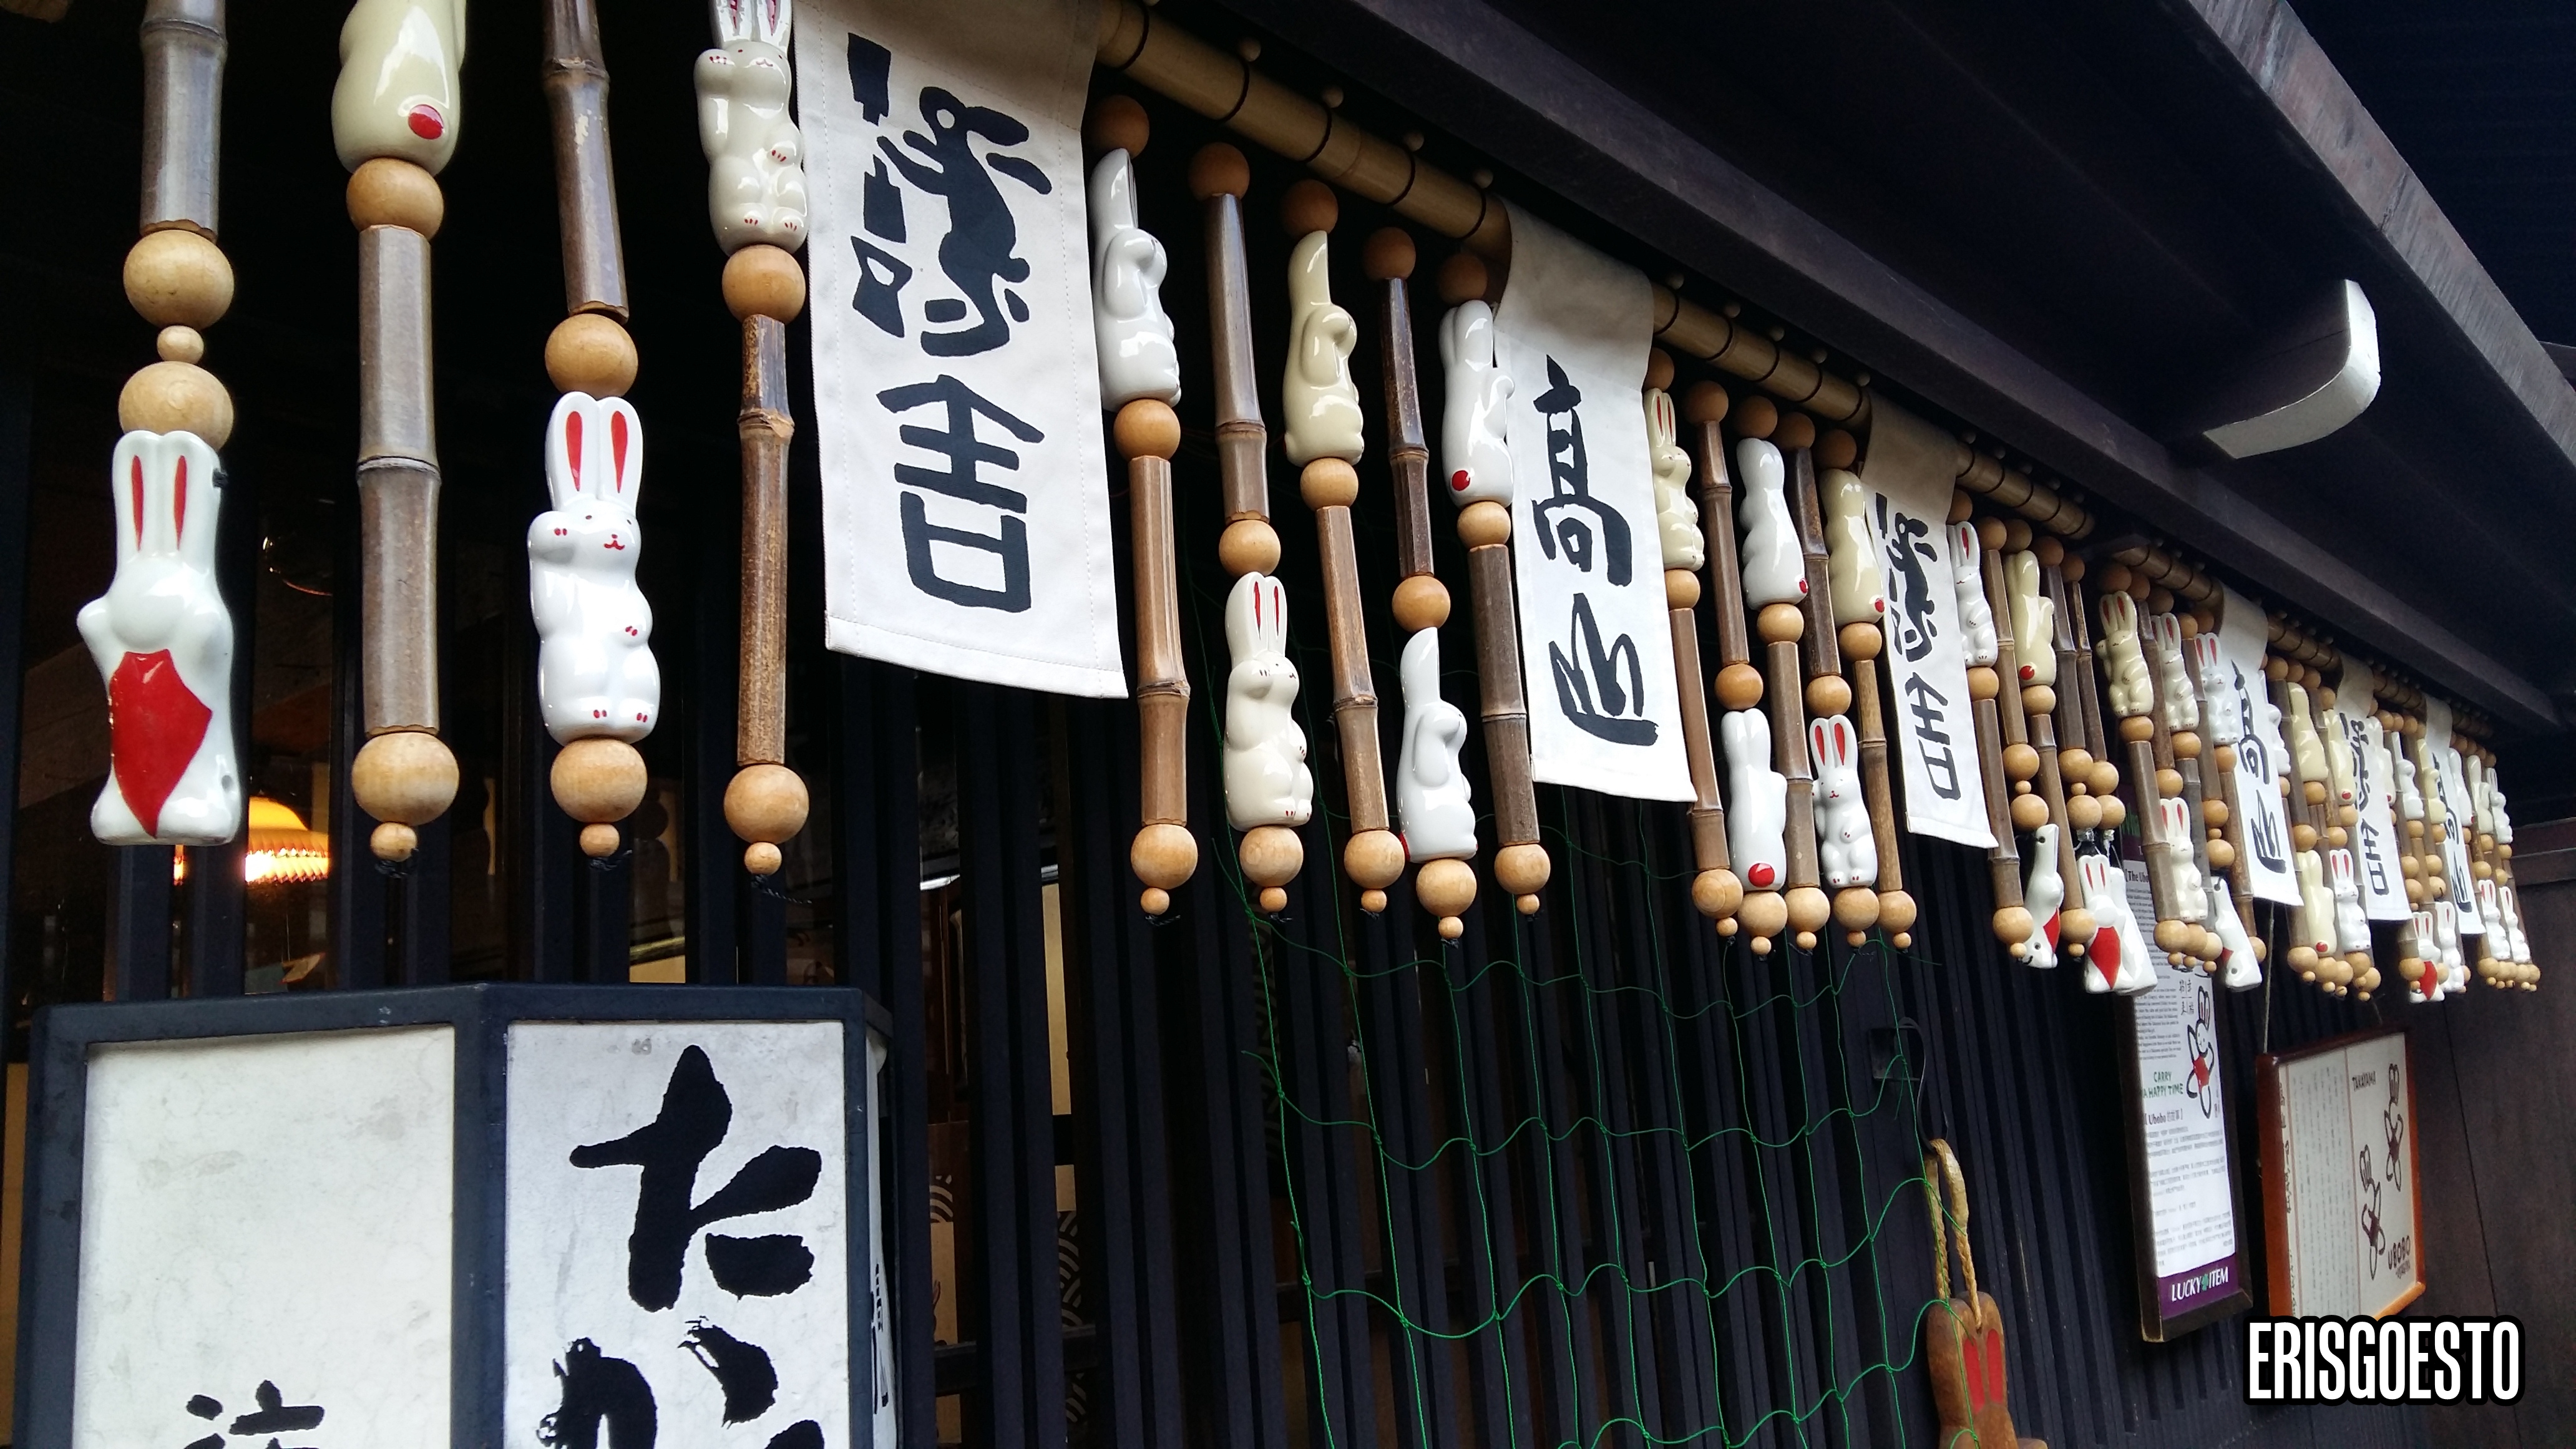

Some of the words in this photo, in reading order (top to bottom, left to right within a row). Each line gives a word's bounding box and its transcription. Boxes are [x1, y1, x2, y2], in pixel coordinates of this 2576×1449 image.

[1531, 354, 1659, 746] 高山
[2154, 1071, 2172, 1083] CARRY
[2149, 1085, 2167, 1098] HAPPY
[2168, 1083, 2183, 1096] TIME
[2172, 1276, 2202, 1302] LUCKY
[2208, 1266, 2228, 1289] ITEM
